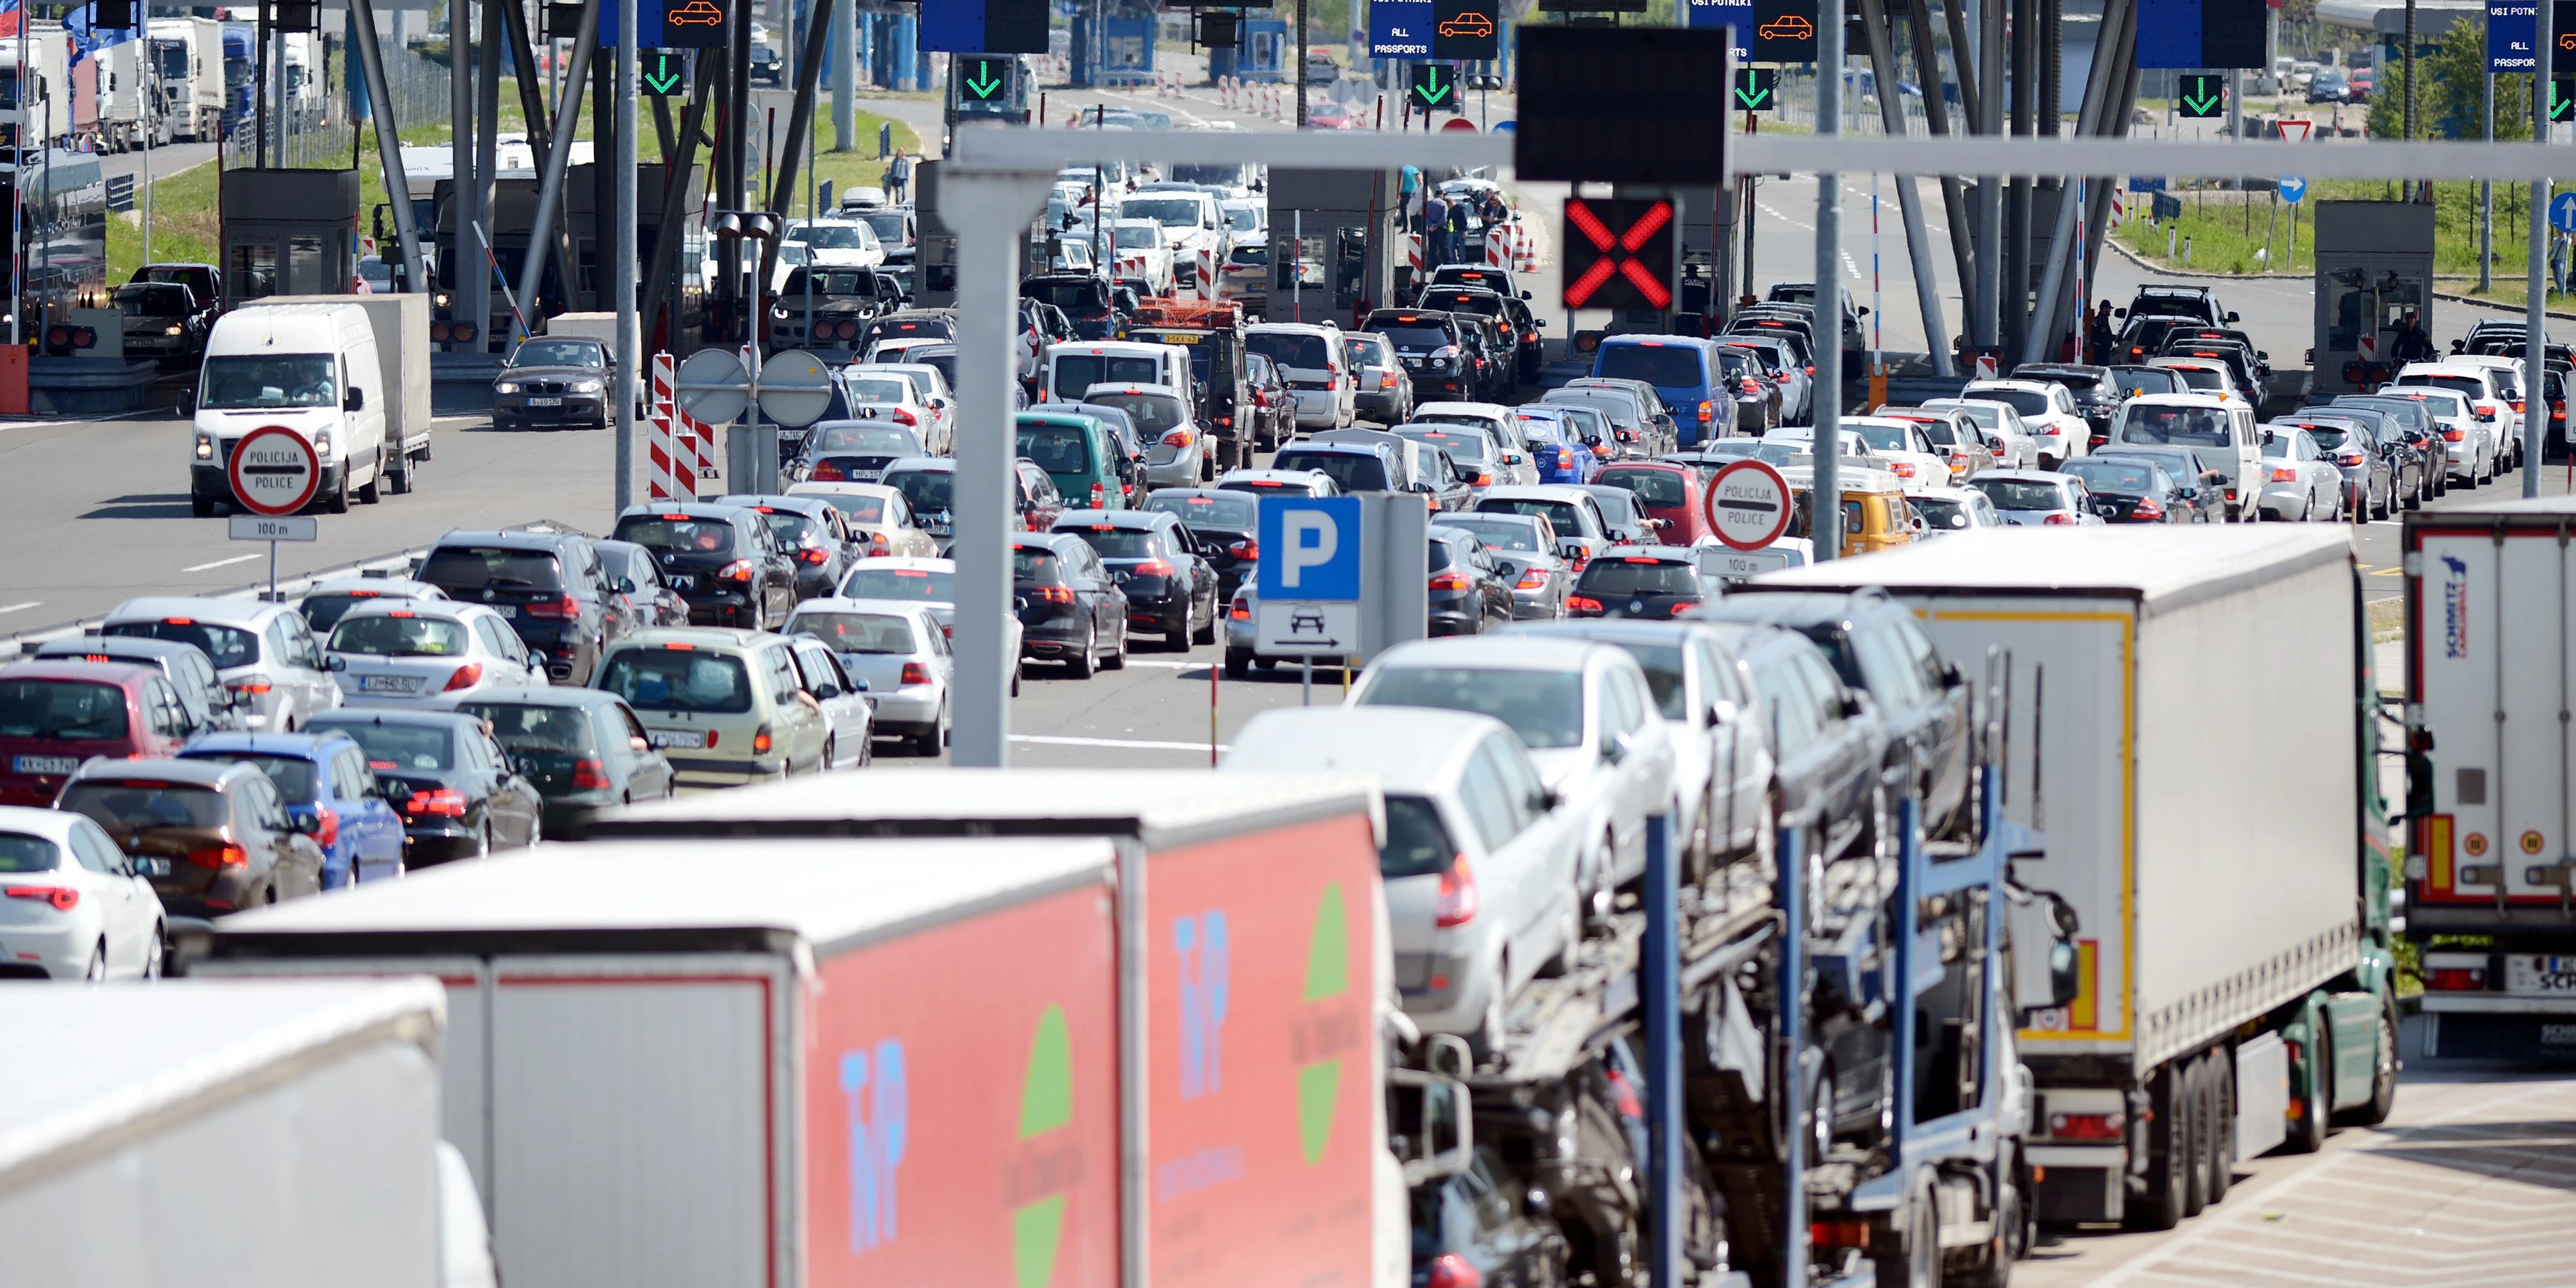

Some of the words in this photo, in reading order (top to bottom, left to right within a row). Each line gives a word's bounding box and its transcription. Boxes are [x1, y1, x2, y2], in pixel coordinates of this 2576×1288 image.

[2490, 7, 2508, 16] VSI
[2510, 7, 2538, 16] POTN
[1391, 28, 1410, 37] ALL
[1374, 44, 1428, 54] PASSPORTS
[2511, 42, 2529, 50] ALL
[2494, 58, 2536, 67] PASSPOR
[250, 451, 299, 463] POLICIJA
[255, 477, 294, 489] POLICE
[1724, 485, 1772, 500] POLICIJA
[1727, 511, 1765, 525] POLICE
[258, 522, 276, 535] 100
[278, 526, 288, 535] m
[1281, 509, 1339, 588] P
[1729, 558, 1746, 571] 100
[1749, 562, 1759, 572] m
